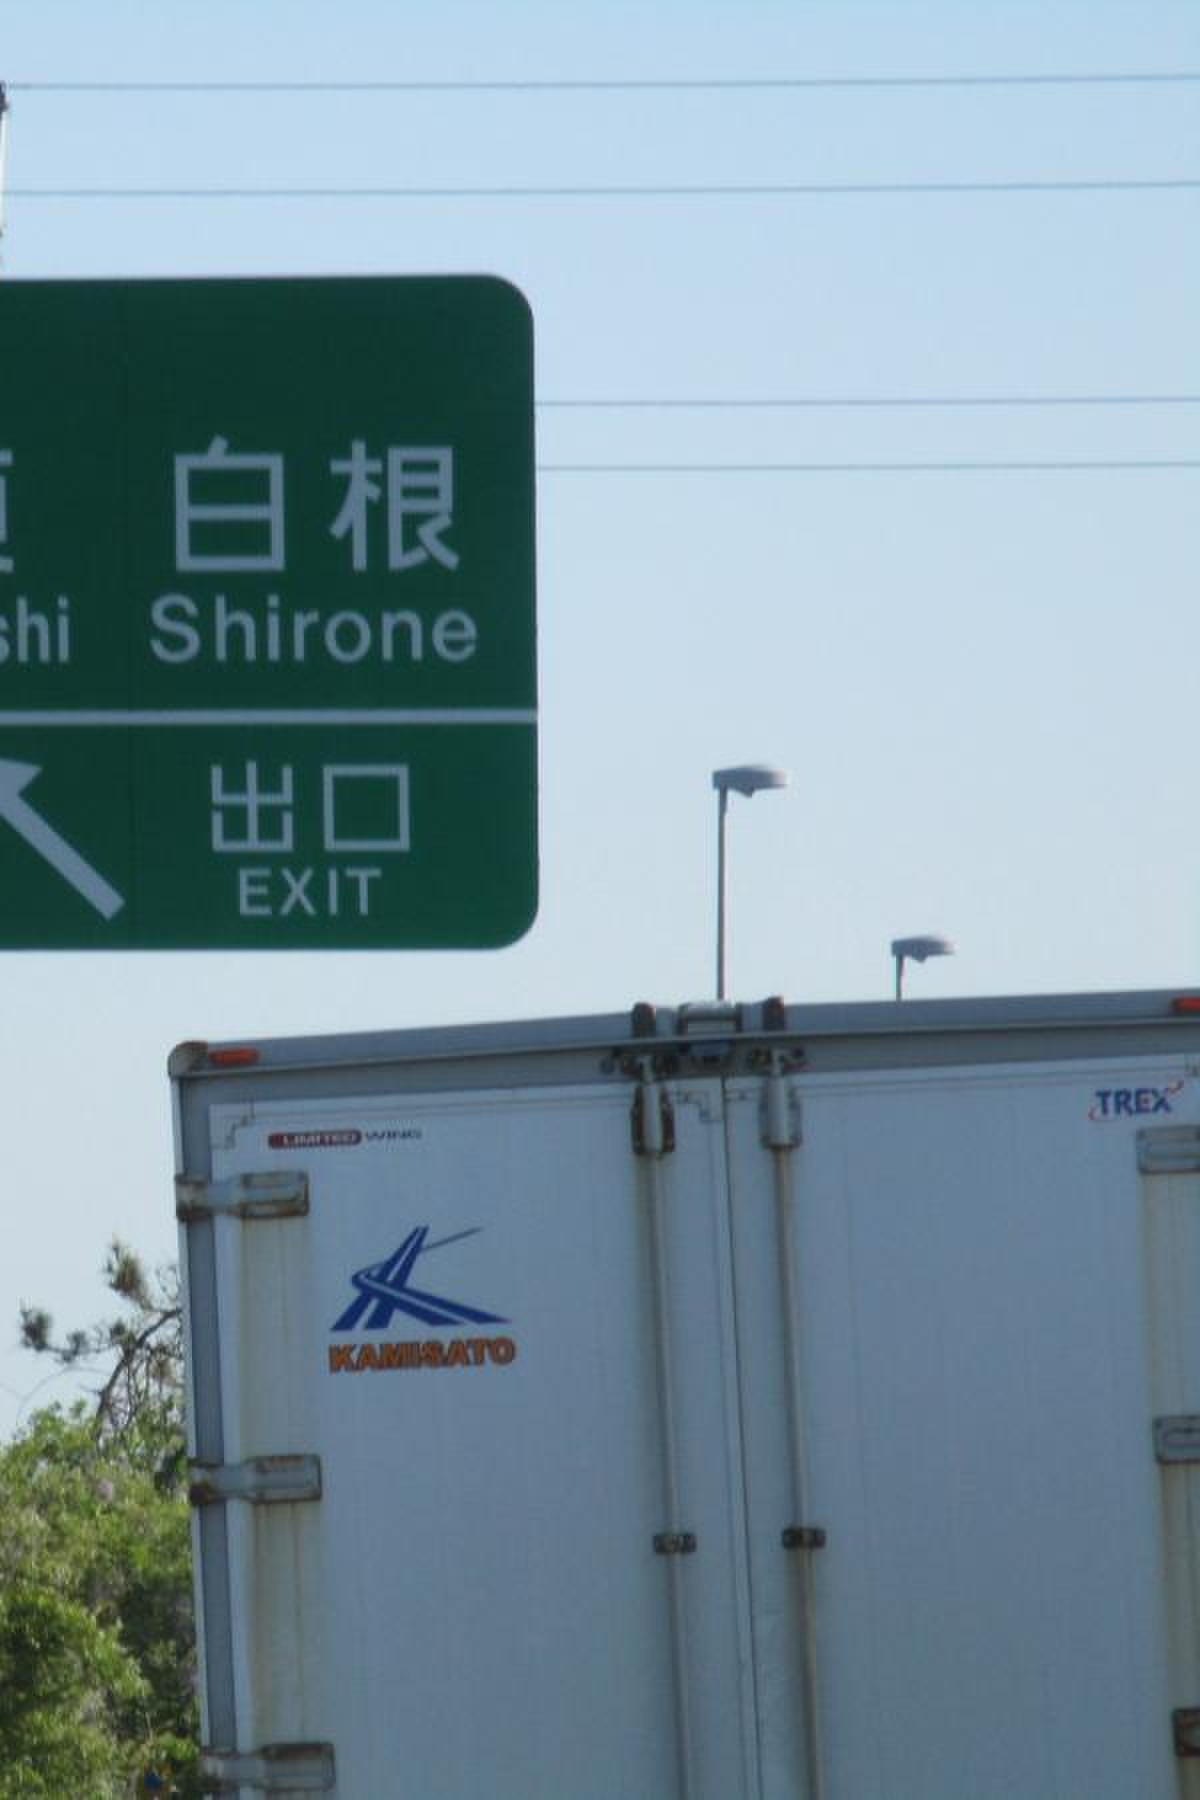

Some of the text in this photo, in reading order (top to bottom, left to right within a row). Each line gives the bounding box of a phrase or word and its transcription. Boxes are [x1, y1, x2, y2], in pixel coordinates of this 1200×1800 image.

[173, 435, 460, 572] 白根
[150, 594, 478, 664] Shirone
[211, 760, 410, 852] 出口
[238, 867, 382, 916] EXIT
[1095, 1087, 1173, 1117] TREX
[328, 1336, 517, 1374] KAMISATO
